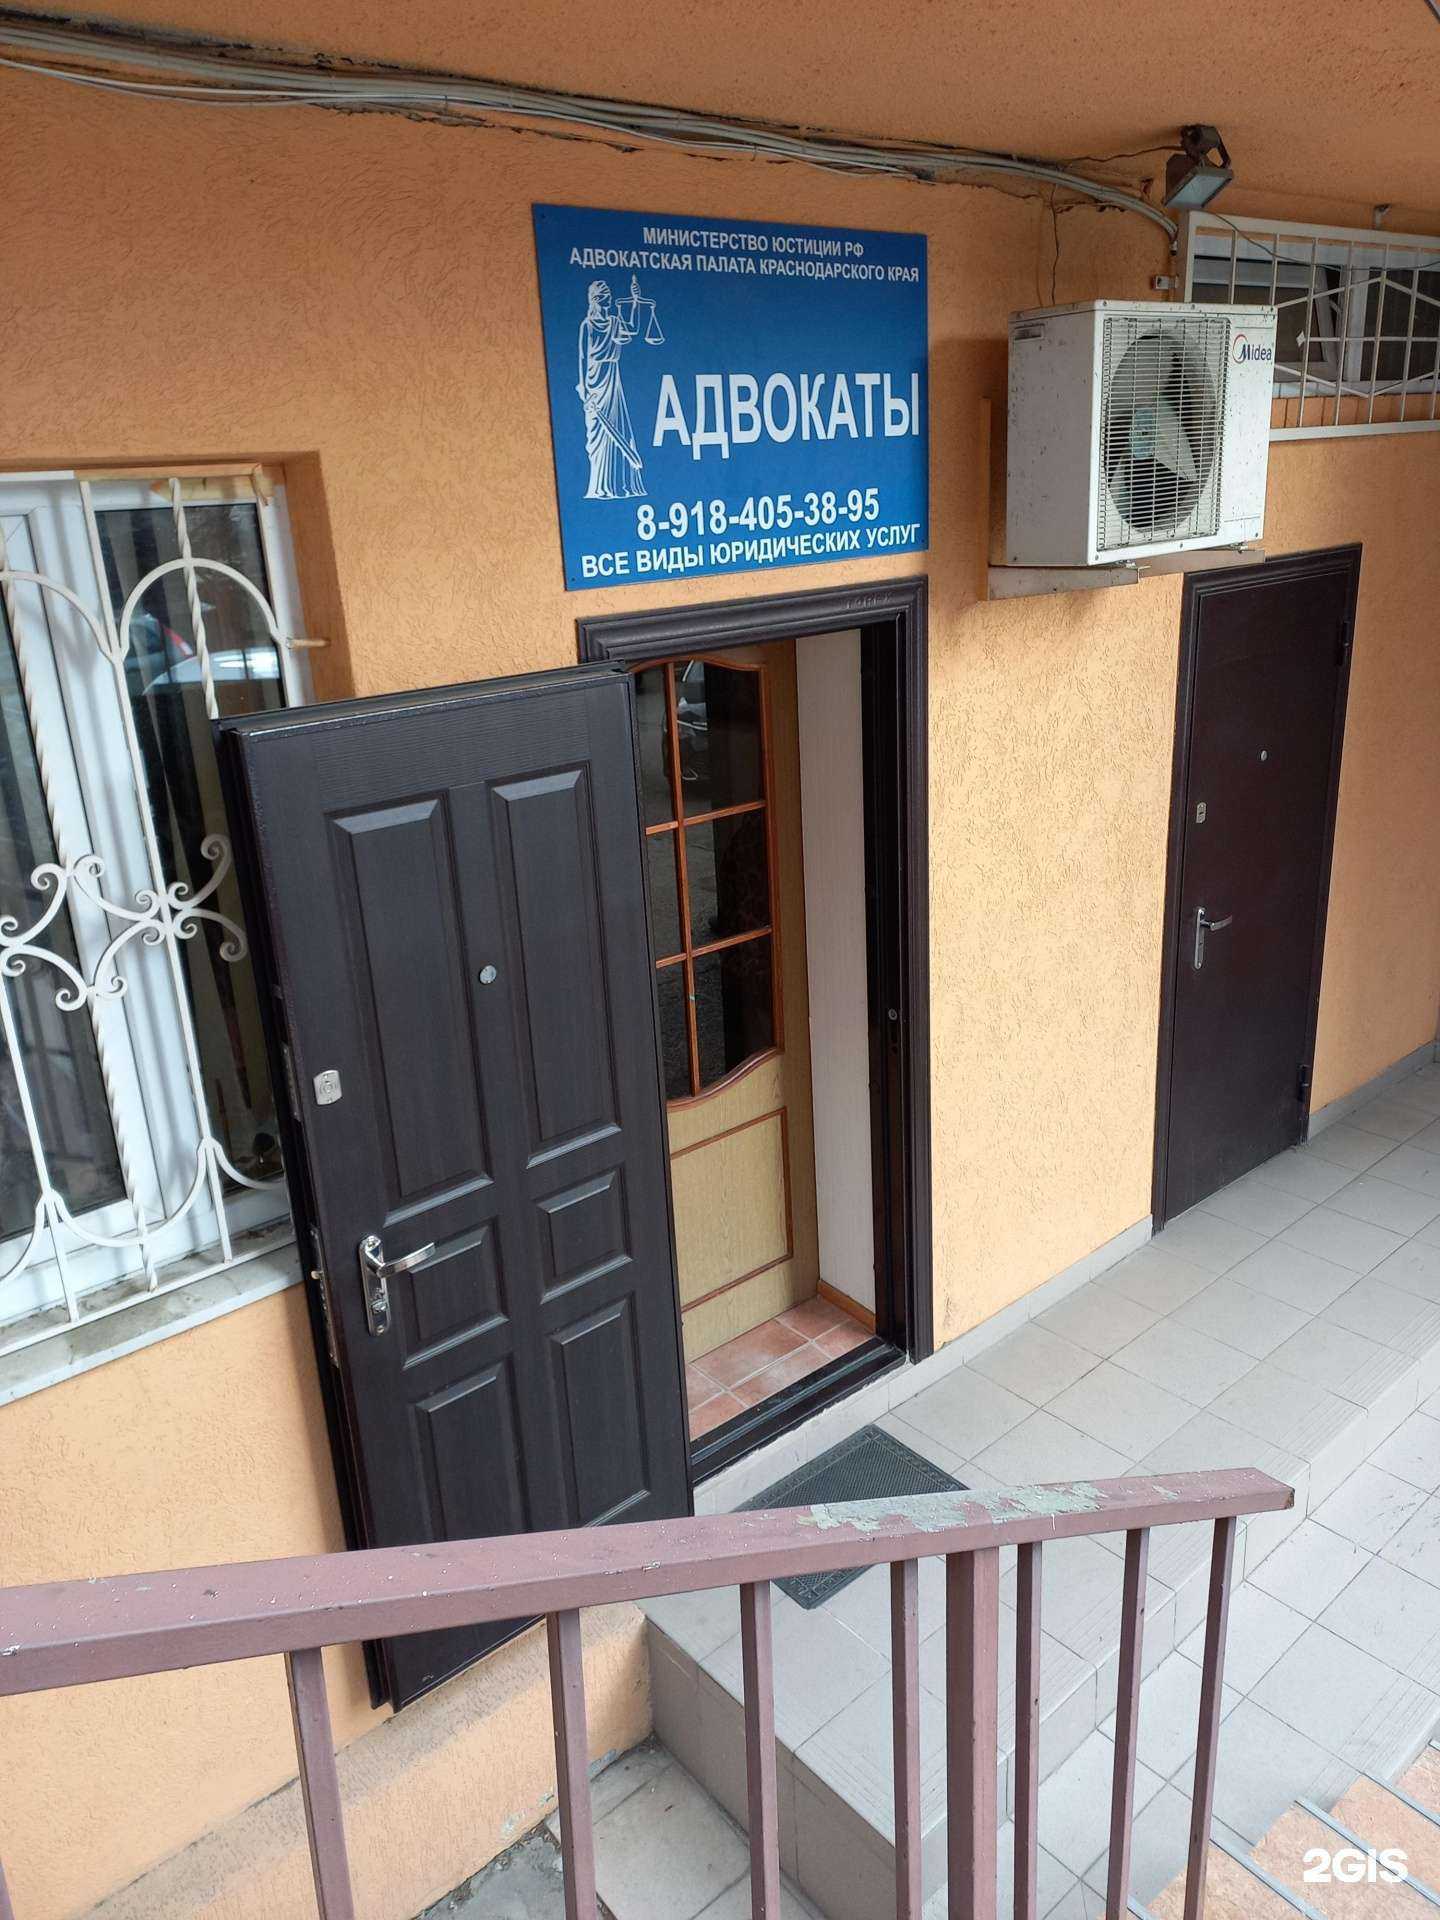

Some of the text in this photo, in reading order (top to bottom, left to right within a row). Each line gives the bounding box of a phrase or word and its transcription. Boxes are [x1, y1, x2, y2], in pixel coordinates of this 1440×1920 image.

[570, 247, 919, 282] АДВОКАТСКАЯ ПАЛАТА КРАСНОДАРСКОГО КРАЯ
[643, 227, 864, 258] МИНИСТЕРСТВО ЮСТИЦИИ РФ
[1232, 333, 1272, 364] Midea
[652, 372, 920, 460] АДВОКАТЫ
[636, 488, 880, 541] 8-918-405-38-95
[581, 523, 921, 579] ВСЕ ВИДЫ ЮРИДИЧЕСКИХ УСЛУГ
